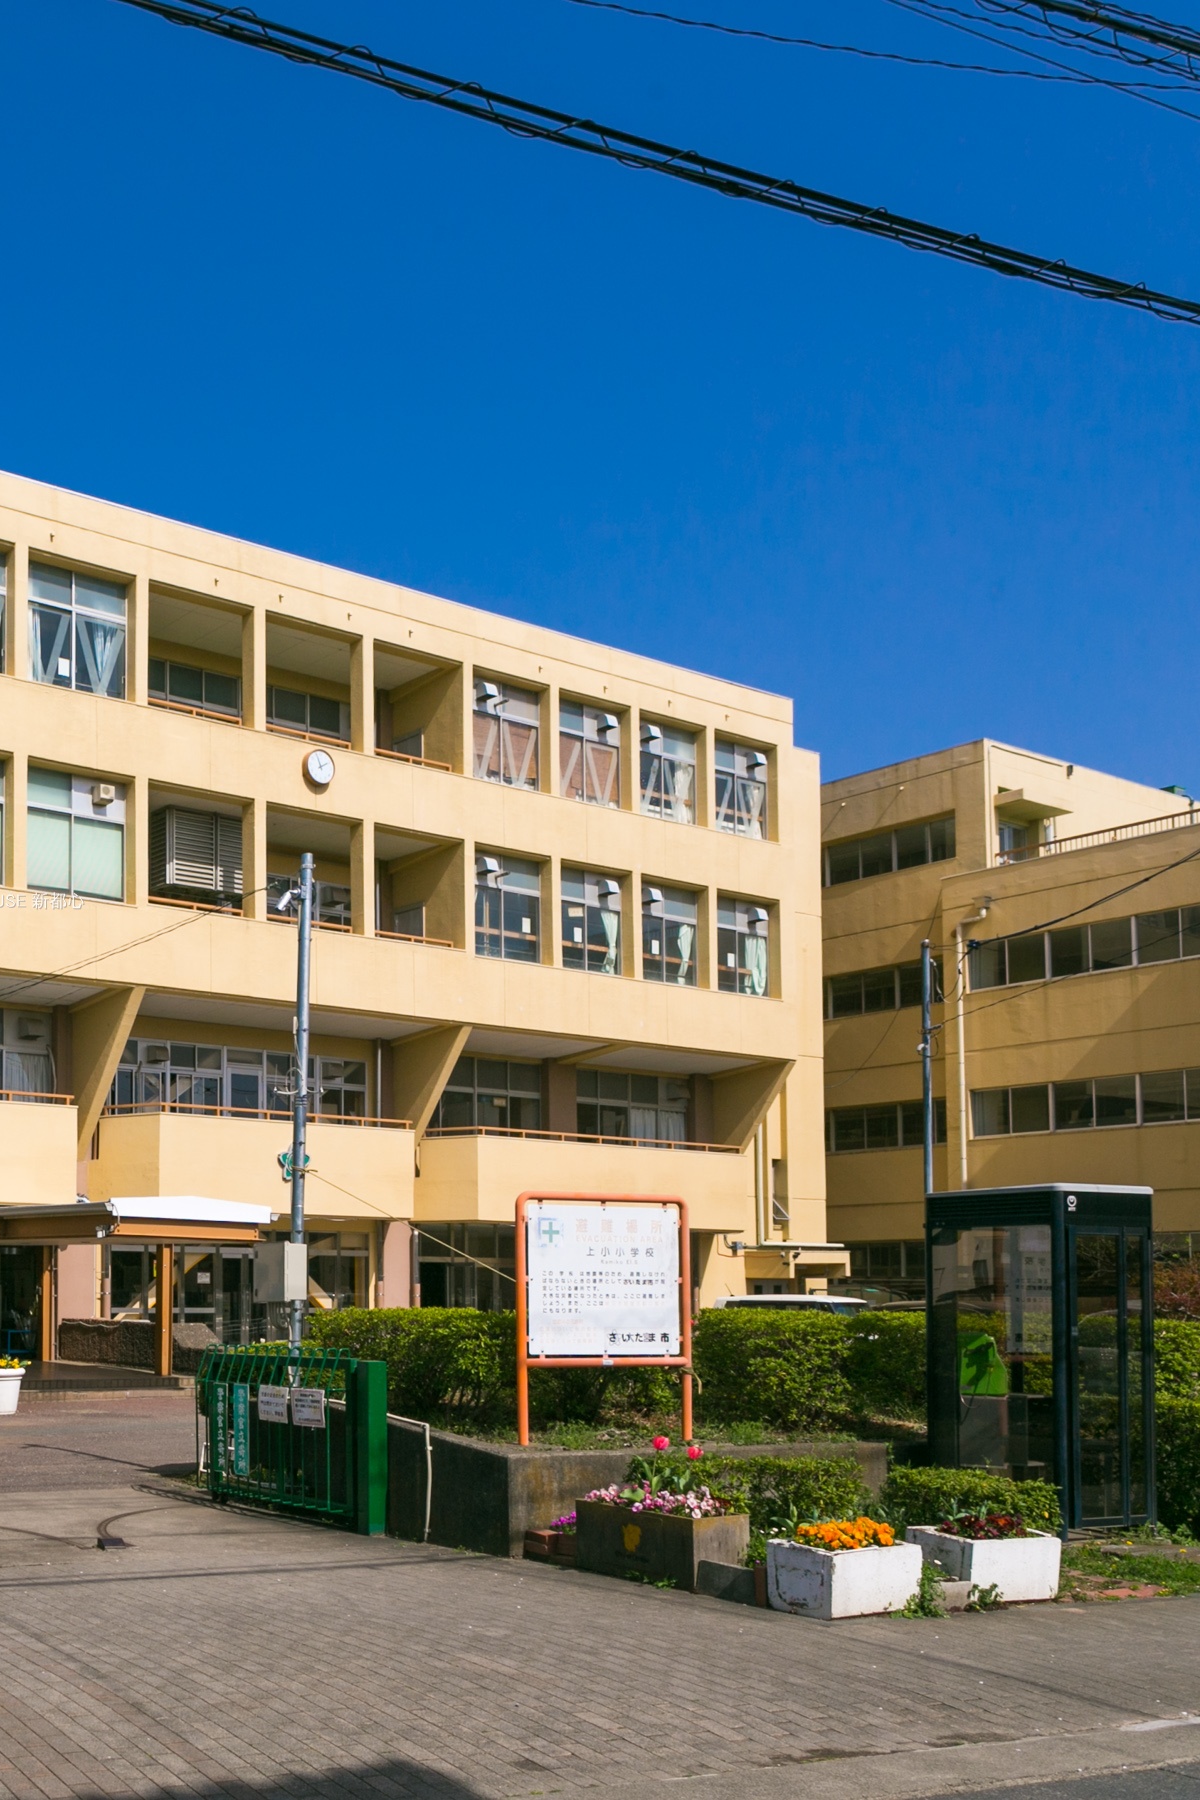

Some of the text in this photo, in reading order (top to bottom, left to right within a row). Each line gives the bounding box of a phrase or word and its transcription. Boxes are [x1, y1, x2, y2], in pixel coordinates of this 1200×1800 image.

[576, 1218, 662, 1233] 避難場所
[576, 1235, 635, 1243] EVACUATION
[586, 1247, 654, 1257] 上小小学校
[608, 1332, 670, 1343] さいたま市
